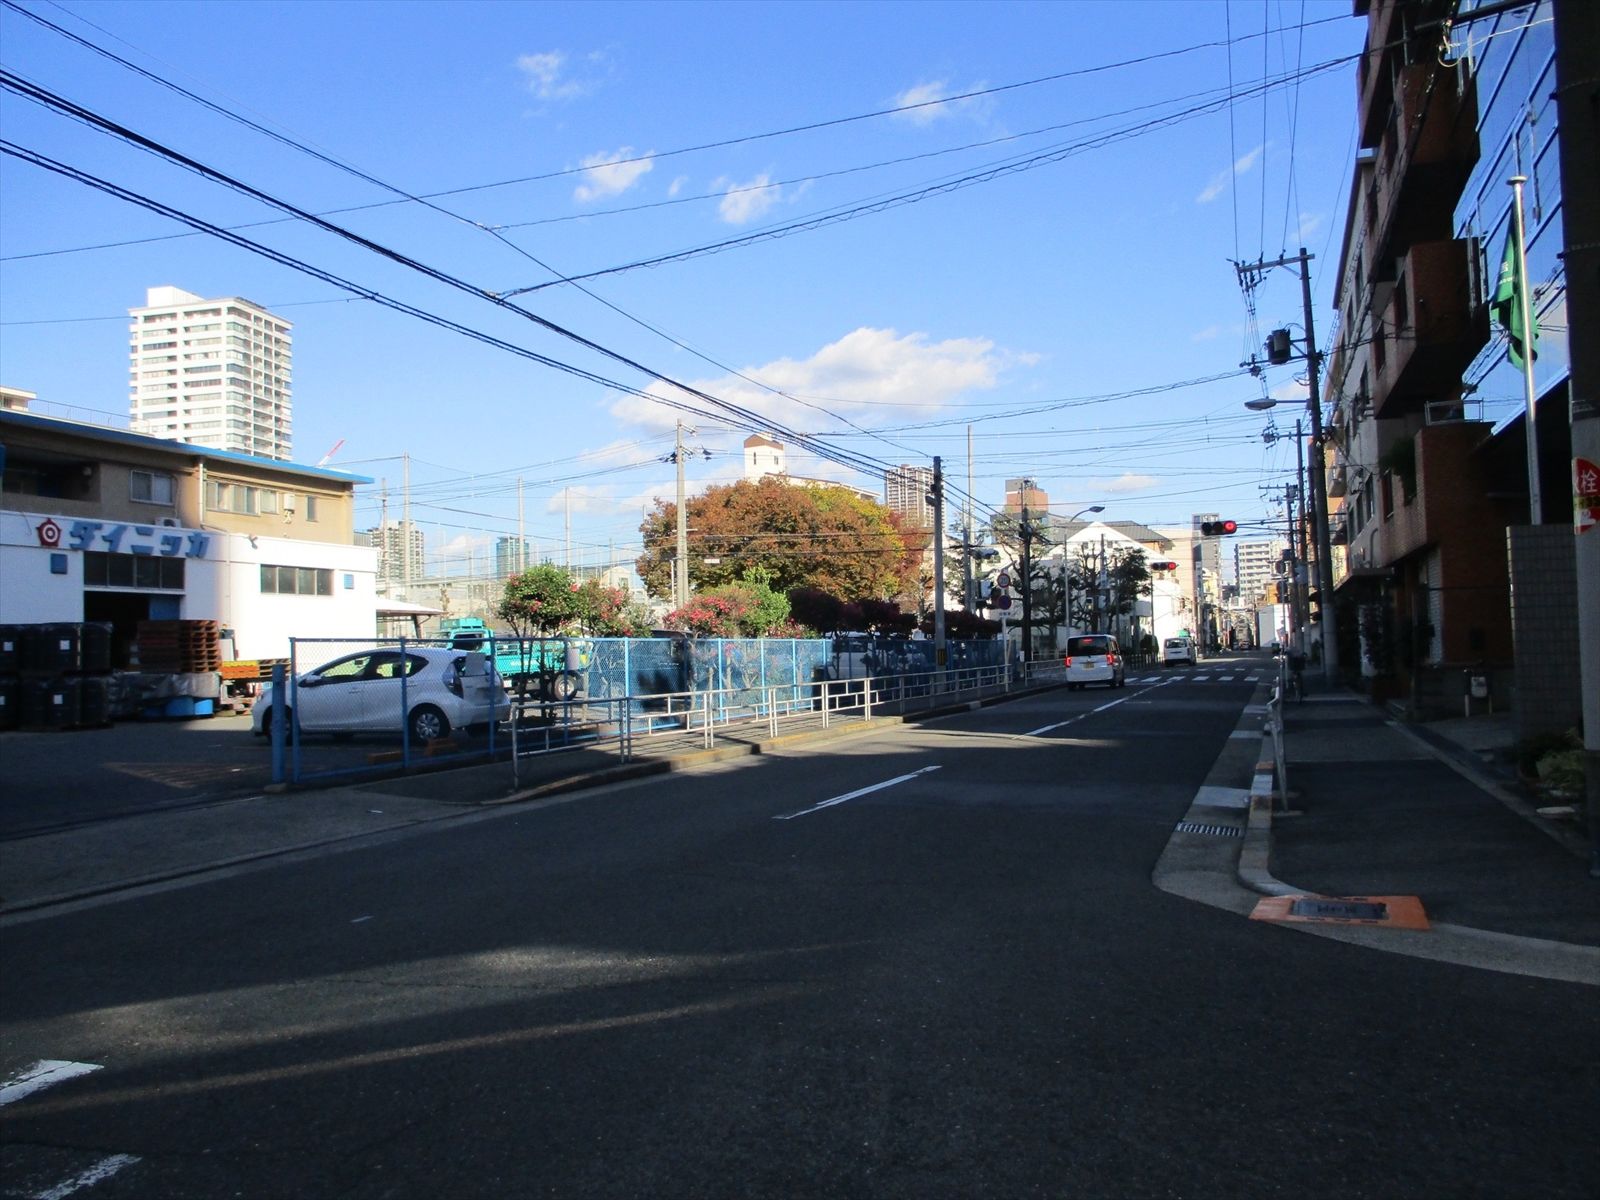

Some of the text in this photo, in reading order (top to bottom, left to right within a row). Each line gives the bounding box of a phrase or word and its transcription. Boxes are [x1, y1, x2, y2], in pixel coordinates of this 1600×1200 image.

[69, 520, 210, 558] ダイニッカ
